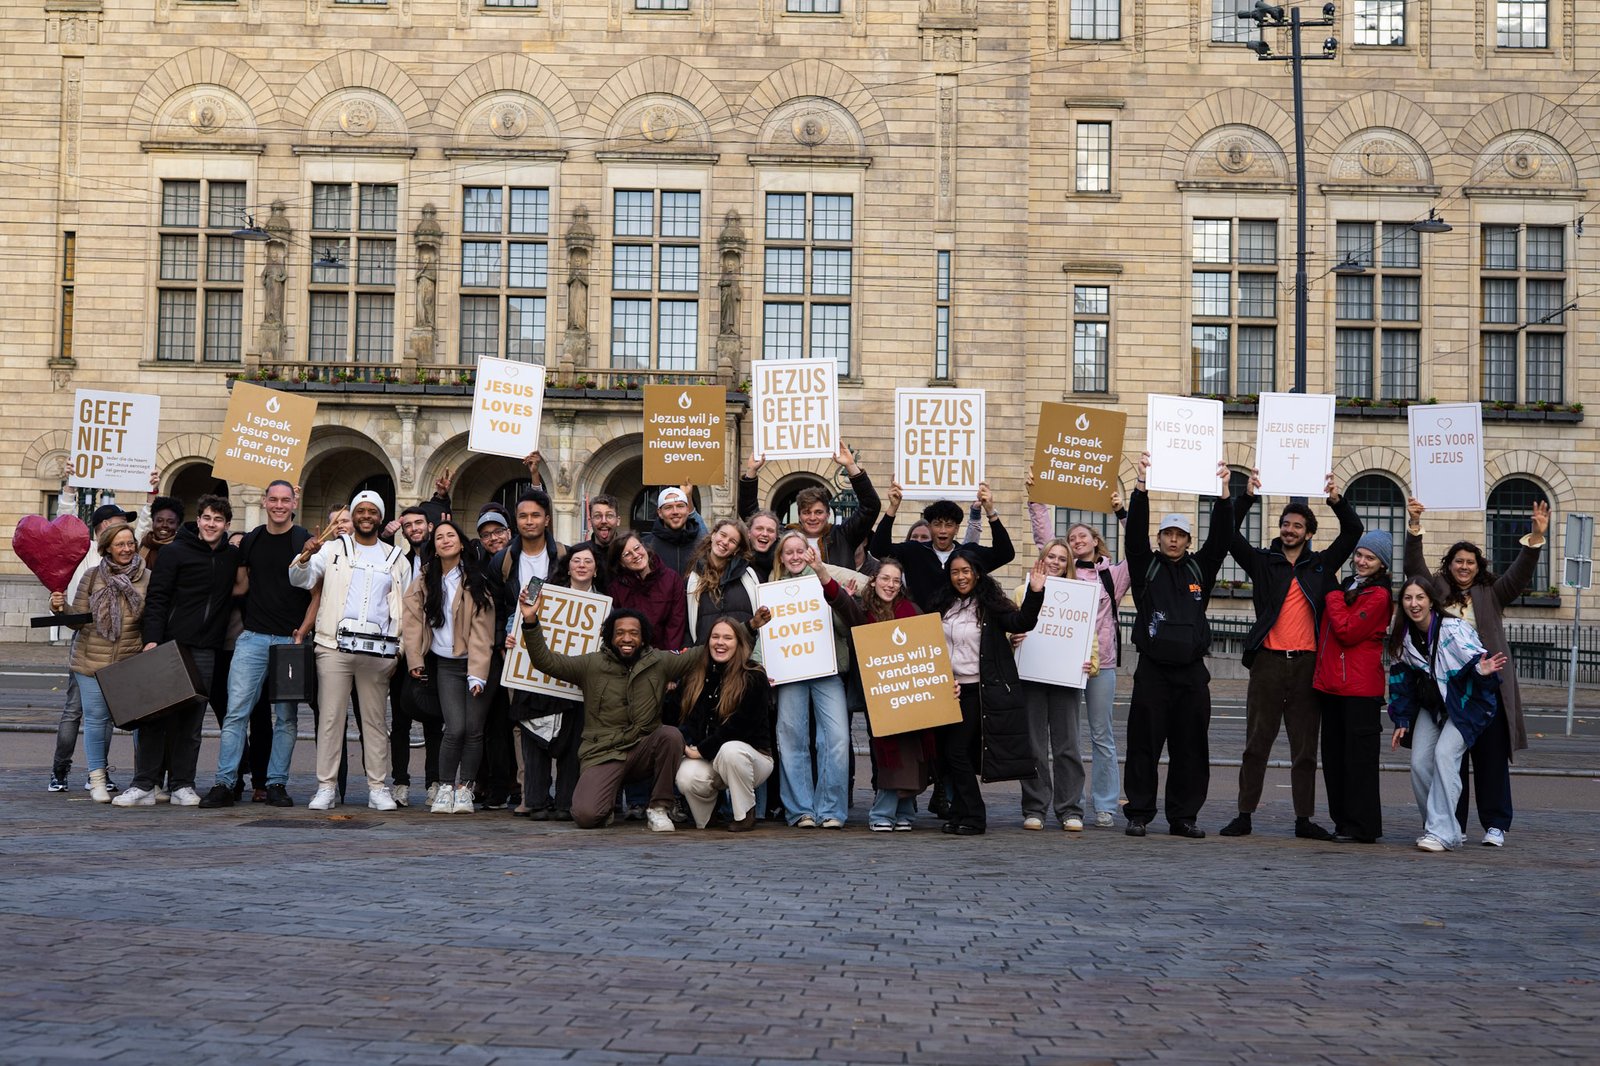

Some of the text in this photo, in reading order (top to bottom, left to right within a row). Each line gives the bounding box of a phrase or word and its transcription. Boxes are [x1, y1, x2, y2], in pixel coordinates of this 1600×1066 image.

[484, 380, 534, 398] JESUS
[762, 368, 826, 395] JEZUS
[80, 398, 133, 426] GEEF
[481, 398, 533, 417] LOVES
[762, 396, 828, 423] GEEFT
[905, 399, 973, 426] JEZUS
[247, 412, 291, 432] I speak
[490, 418, 522, 435] YOU
[650, 413, 720, 426] Jezus wil je
[1155, 421, 1214, 436] KIES VOOR
[1265, 422, 1327, 434] JEZUS GEEFT
[78, 426, 127, 453] NIET
[232, 422, 300, 446] Jesus over
[658, 426, 710, 438] vandaag
[764, 424, 830, 450] LEVEN
[1057, 432, 1102, 448] I speak
[1416, 433, 1475, 447] KIES VOOR
[237, 435, 290, 457] fear and
[649, 438, 720, 448] nieuw leven
[905, 428, 975, 456] GEEFT
[1167, 438, 1202, 451] JEZUS
[1280, 438, 1310, 448] LEVEN
[225, 447, 294, 472] all anxiety.
[664, 453, 704, 464] geven.
[1044, 444, 1113, 463] Jesus over
[1429, 452, 1464, 464] JEZUS
[76, 454, 103, 478] OP
[905, 459, 975, 486] LEVEN
[1050, 457, 1103, 474] fear and
[1040, 470, 1109, 490] all anxiety.
[538, 595, 596, 630] EZUS
[1059, 608, 1088, 623] VOOR
[769, 619, 824, 640] LOVES
[1038, 623, 1074, 638] JEZUS
[780, 641, 815, 658] YOU
[866, 645, 941, 667] Jezus wil je
[877, 662, 935, 680] vandaag
[870, 674, 948, 695] nieuw leven
[890, 692, 935, 709] geven.
